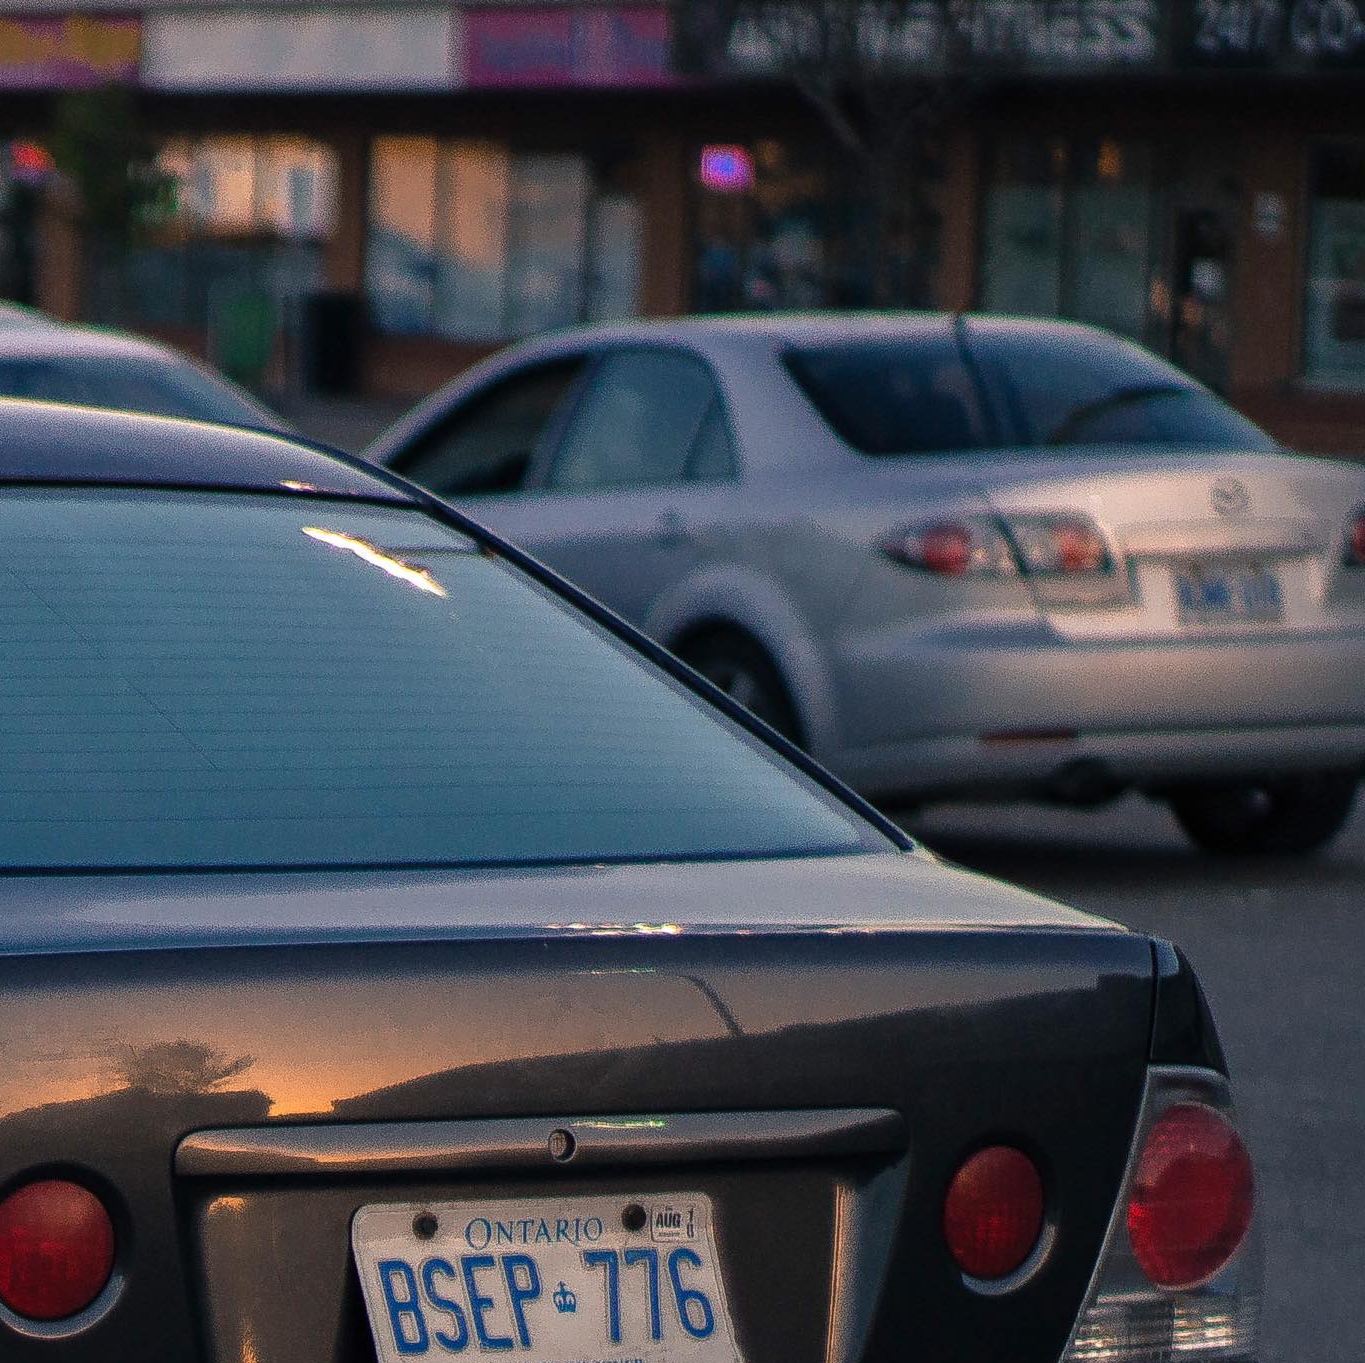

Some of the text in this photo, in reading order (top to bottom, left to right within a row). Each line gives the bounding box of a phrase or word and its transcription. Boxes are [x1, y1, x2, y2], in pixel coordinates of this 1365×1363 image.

[464, 1216, 604, 1250] ONTARIO
[655, 1211, 681, 1229] AUG
[377, 1247, 716, 1356] BSEP 776
